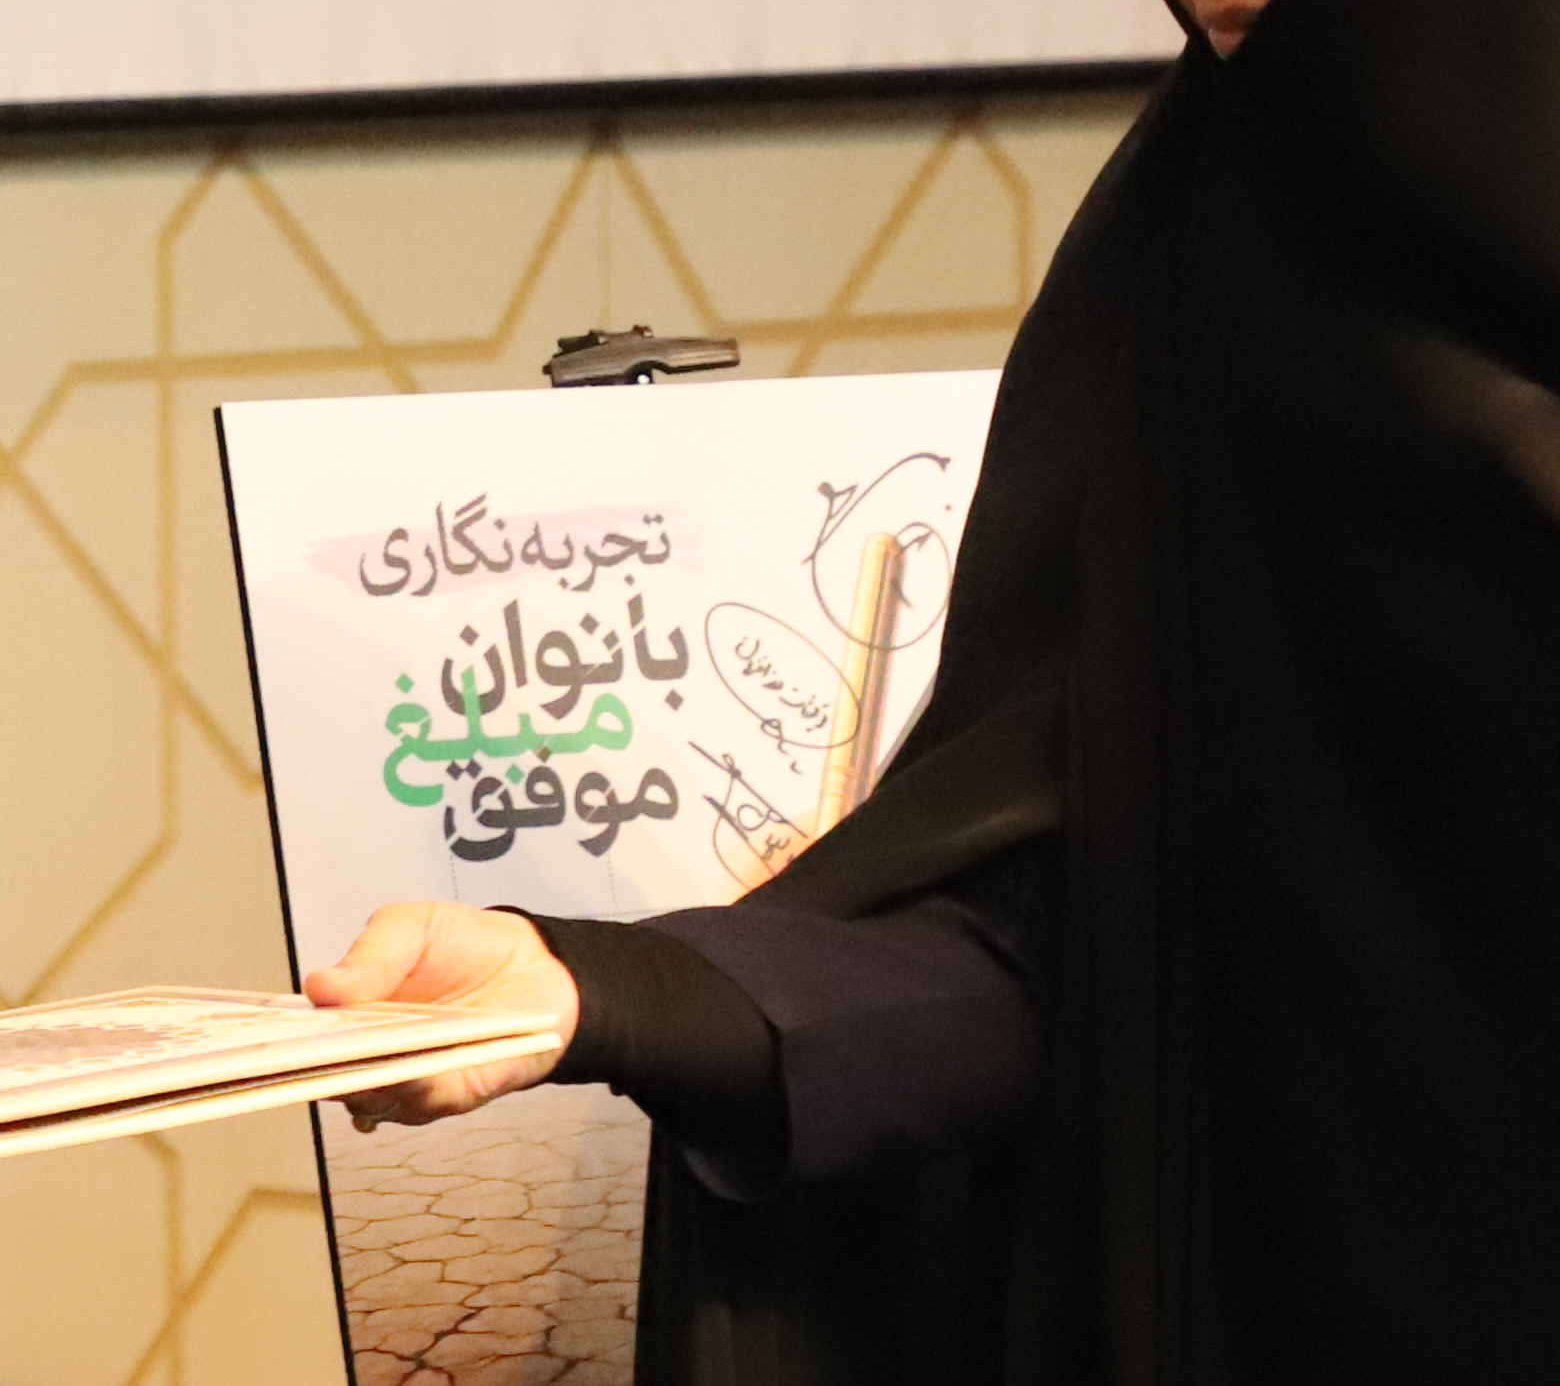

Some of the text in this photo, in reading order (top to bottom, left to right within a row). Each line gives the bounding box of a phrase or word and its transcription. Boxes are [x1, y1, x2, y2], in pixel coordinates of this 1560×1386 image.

[441, 593, 690, 720] بانوان
[383, 665, 633, 807] مبلغ
[444, 746, 679, 863] موفق
